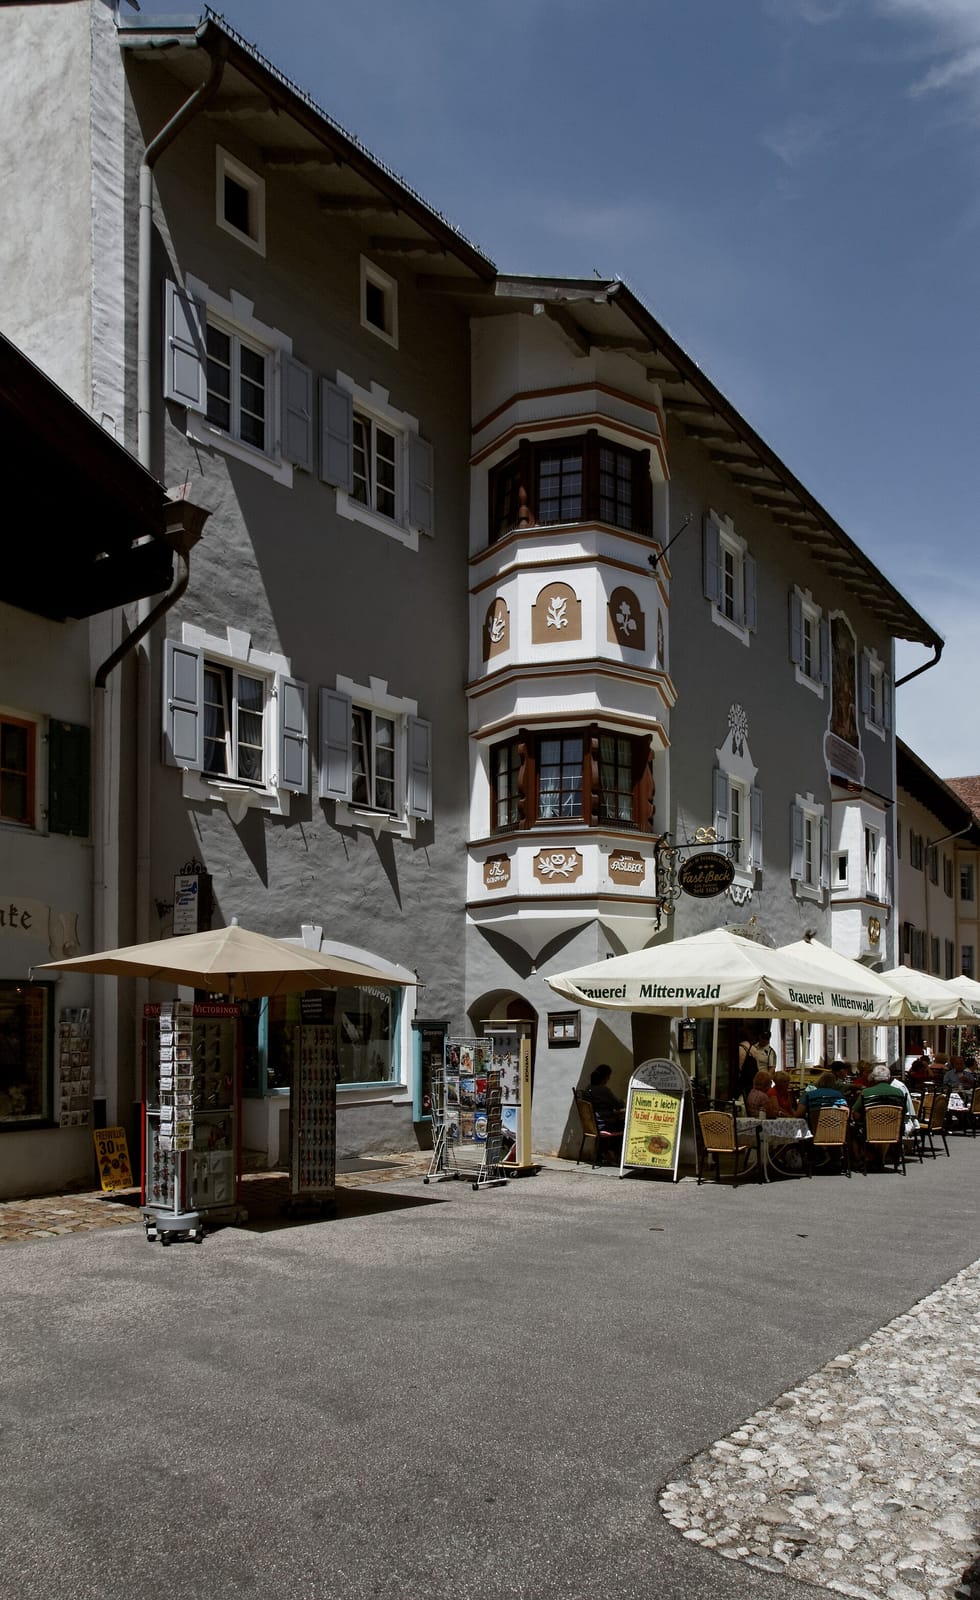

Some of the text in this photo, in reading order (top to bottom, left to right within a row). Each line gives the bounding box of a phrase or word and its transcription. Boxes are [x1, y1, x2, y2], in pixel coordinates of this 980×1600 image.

[639, 984, 721, 999] Mittenwald
[788, 988, 875, 1012] Brauerei Mittenwald
[99, 1140, 115, 1155] 30
